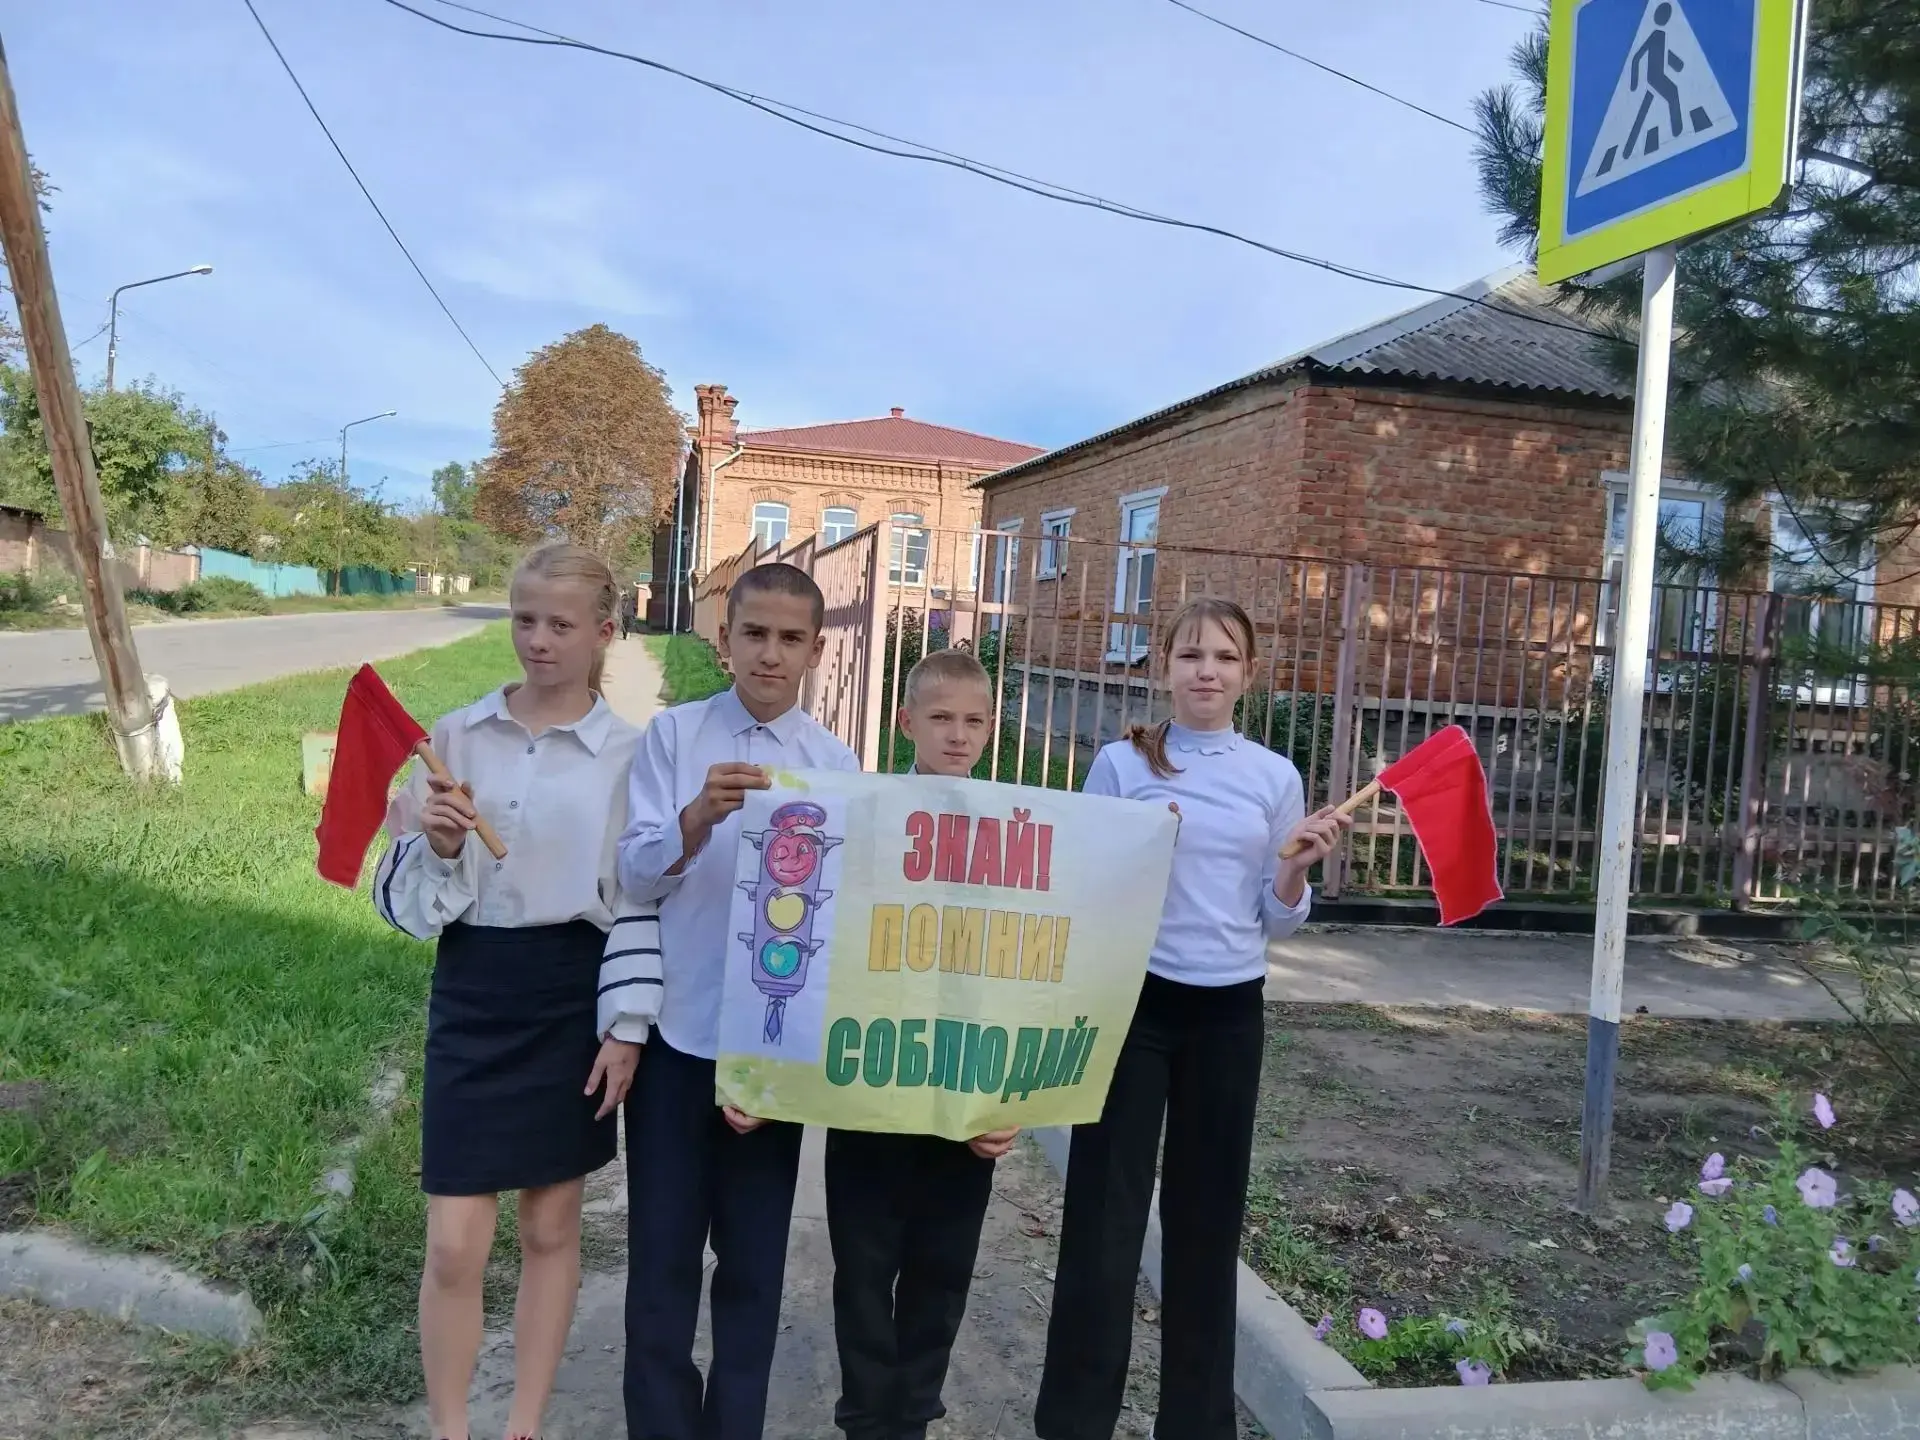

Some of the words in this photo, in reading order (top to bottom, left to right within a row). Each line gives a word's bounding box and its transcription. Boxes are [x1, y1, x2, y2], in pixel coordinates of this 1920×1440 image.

[903, 807, 1054, 891] ЗНАЙ!
[868, 903, 1071, 983] ПОМНИ!
[825, 1015, 1099, 1104] СОБЛЮДАЙ!
